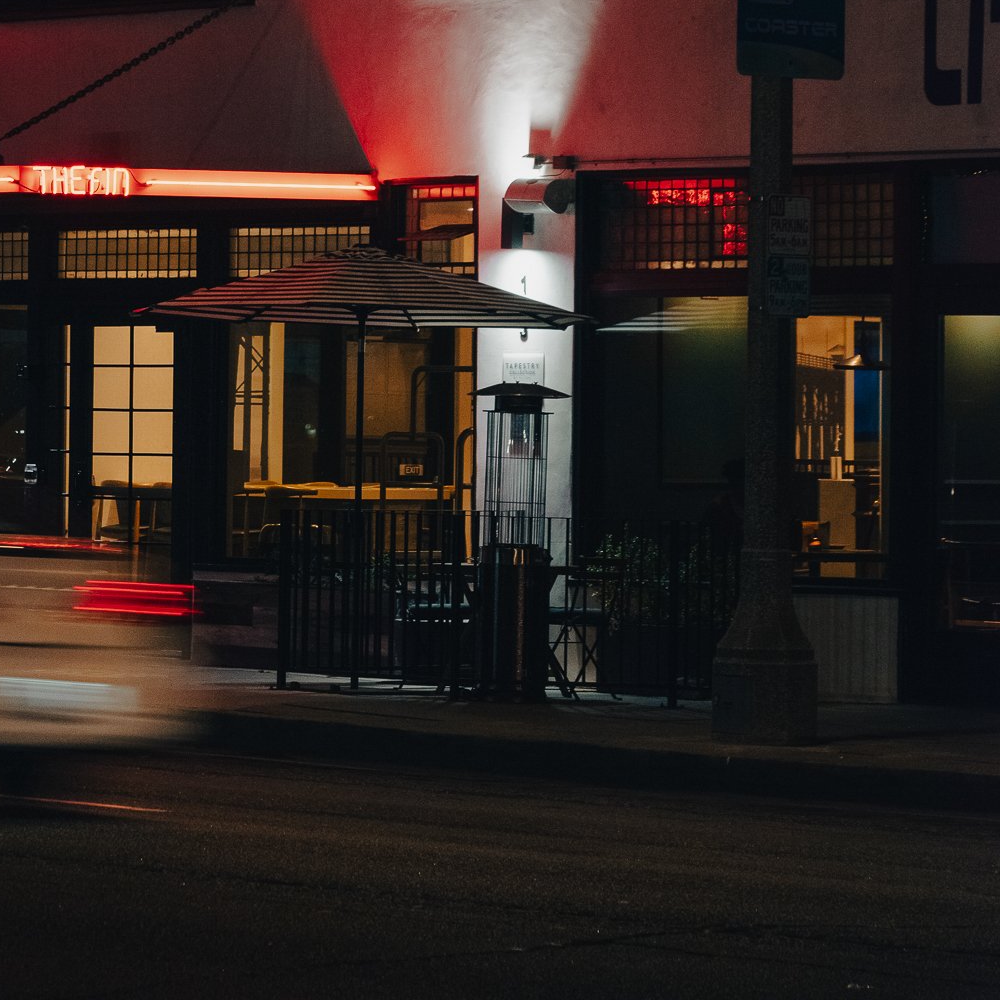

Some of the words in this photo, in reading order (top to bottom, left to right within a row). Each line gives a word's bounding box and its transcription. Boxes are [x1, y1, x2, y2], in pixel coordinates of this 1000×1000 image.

[745, 17, 837, 37] COASTER
[32, 165, 86, 196] THE
[87, 167, 130, 197] FIN
[770, 218, 808, 233] PARKING
[405, 466, 420, 474] EXIT
